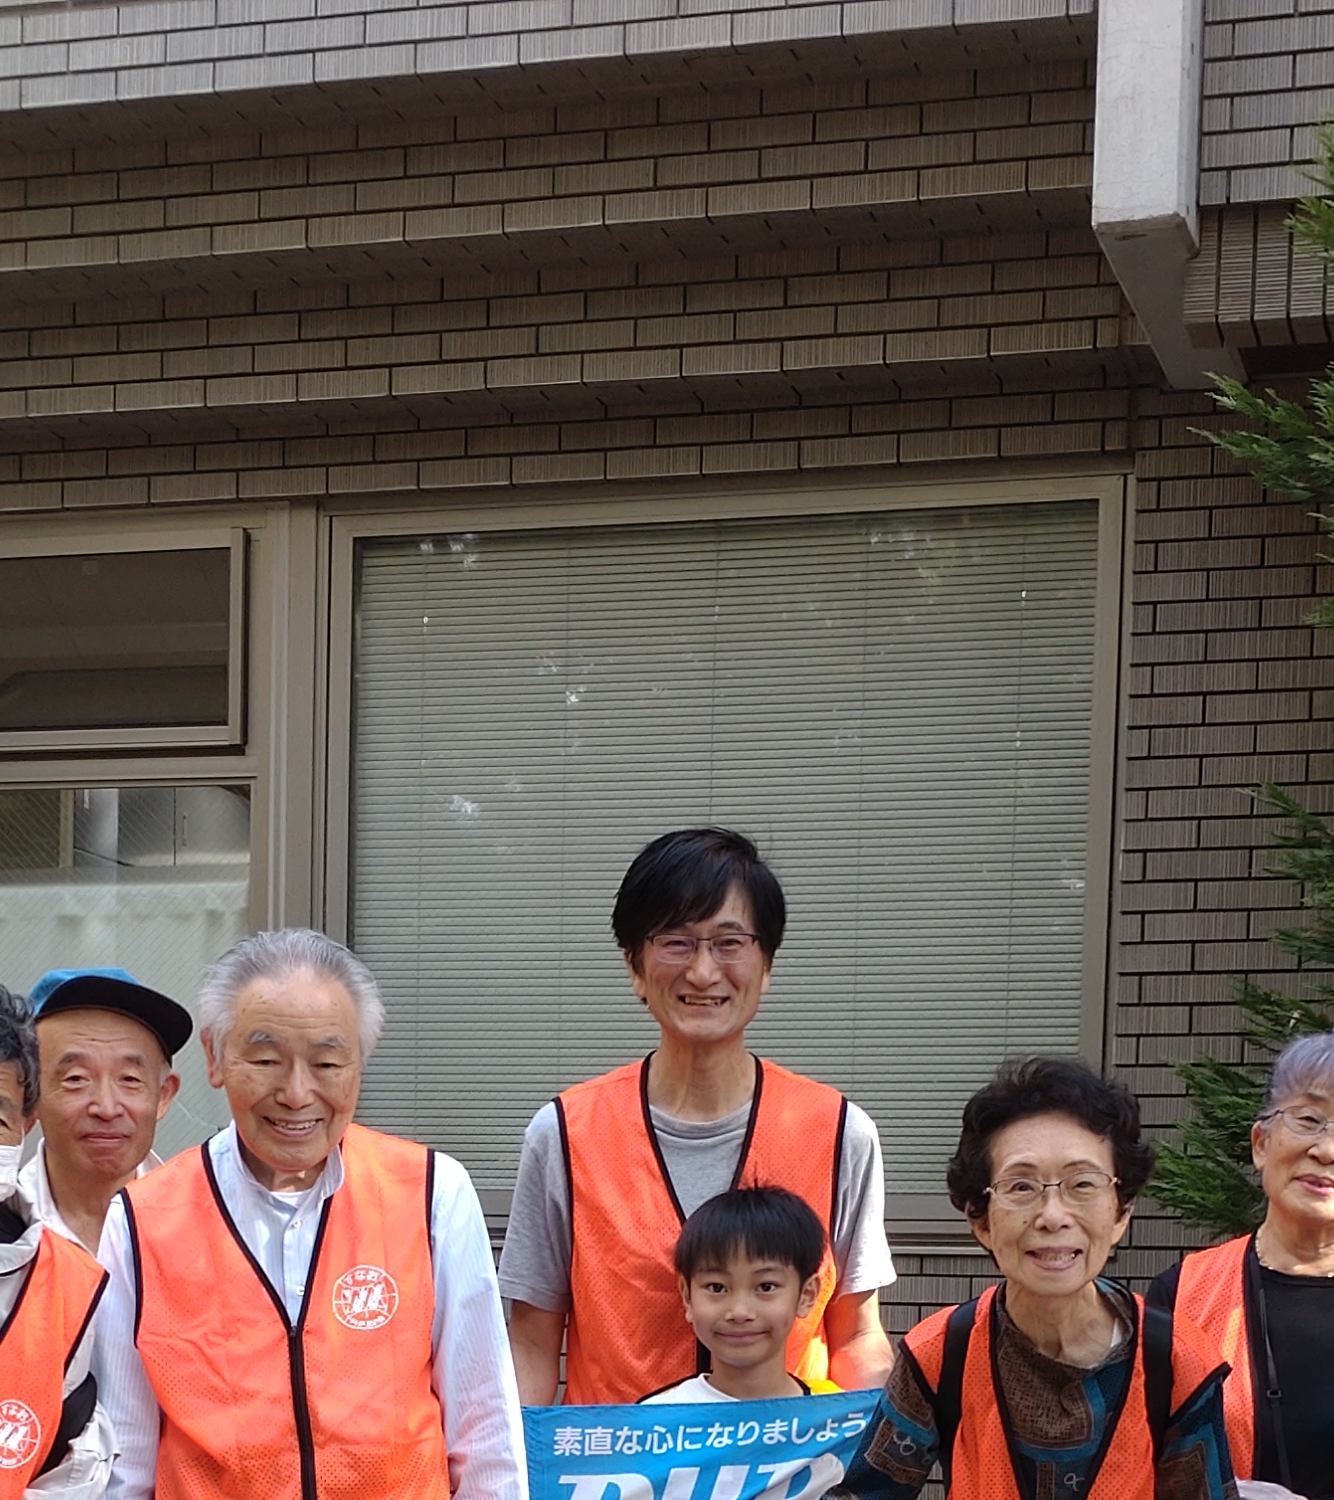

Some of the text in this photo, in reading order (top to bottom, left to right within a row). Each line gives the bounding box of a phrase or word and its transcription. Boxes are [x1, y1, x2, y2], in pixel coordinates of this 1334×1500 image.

[553, 1414, 867, 1456] 素直な心になりましょう
